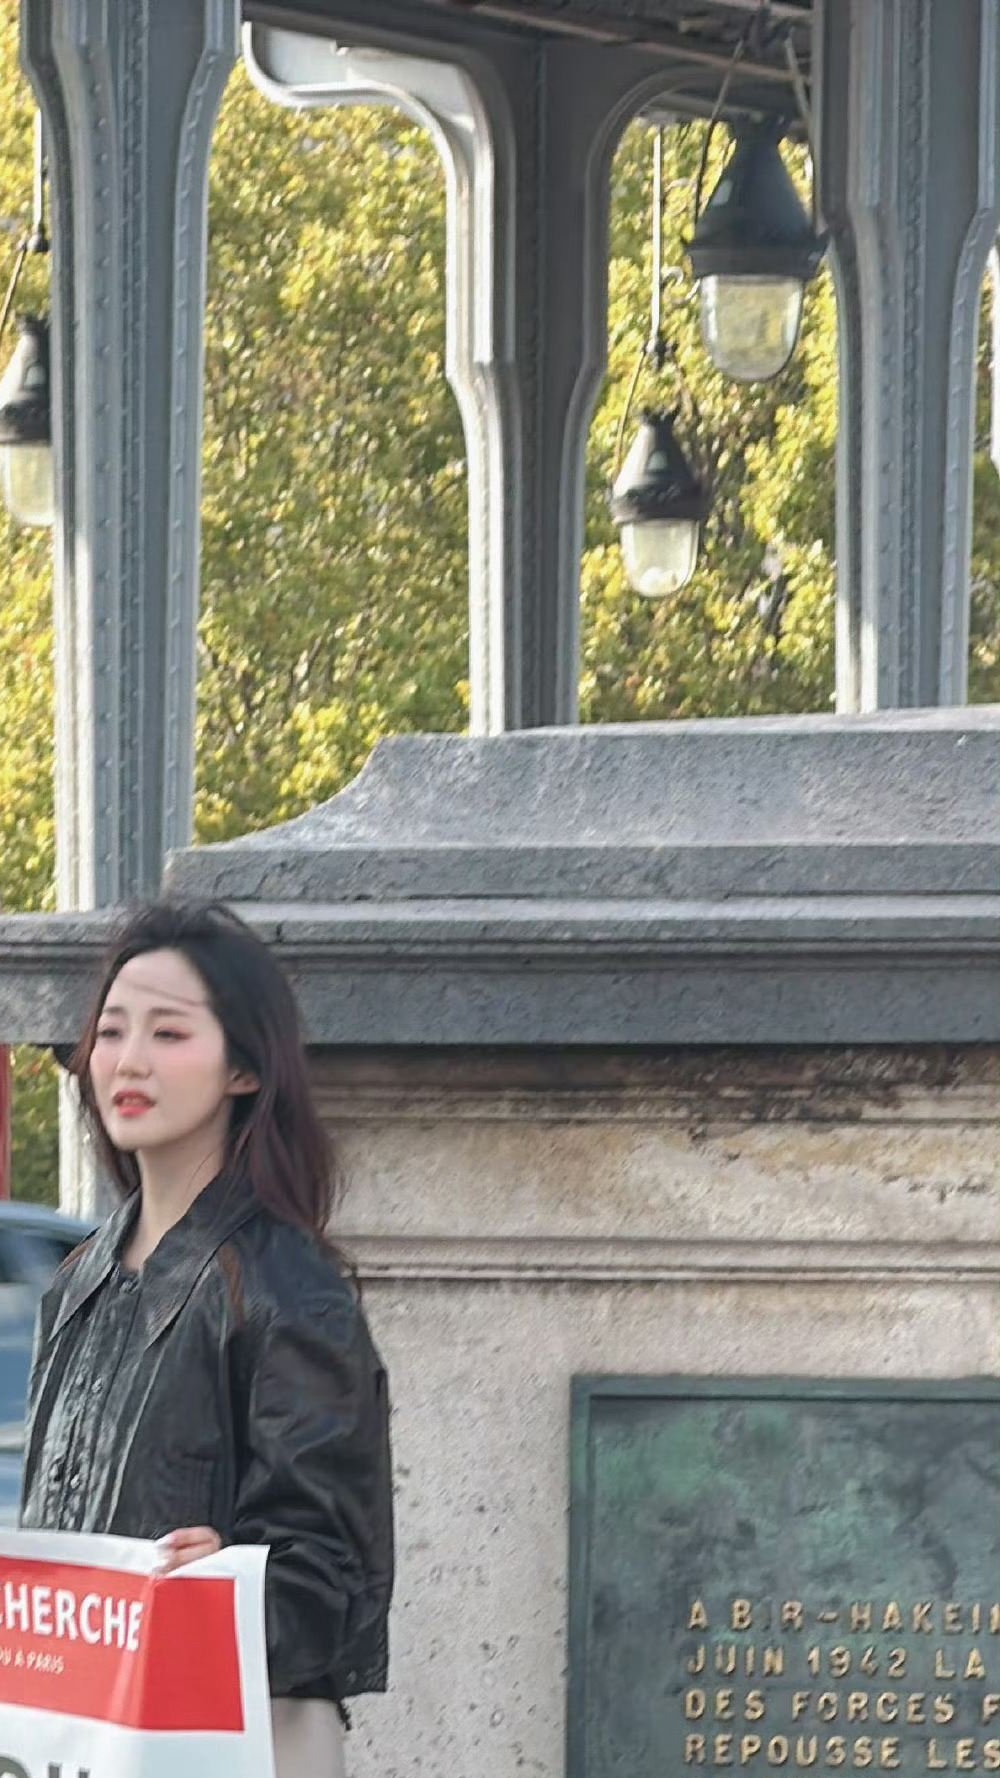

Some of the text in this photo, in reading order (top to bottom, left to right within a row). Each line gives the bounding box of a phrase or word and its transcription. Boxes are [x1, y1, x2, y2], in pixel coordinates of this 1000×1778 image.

[688, 1600, 708, 1630] A
[27, 1651, 64, 1675] PARIS
[688, 1645, 985, 1680] JUIN 1942 LA
[685, 1688, 765, 1722] DES
[792, 1691, 954, 1724] FORCES
[685, 1733, 1000, 1769] REPOUSSE LES
